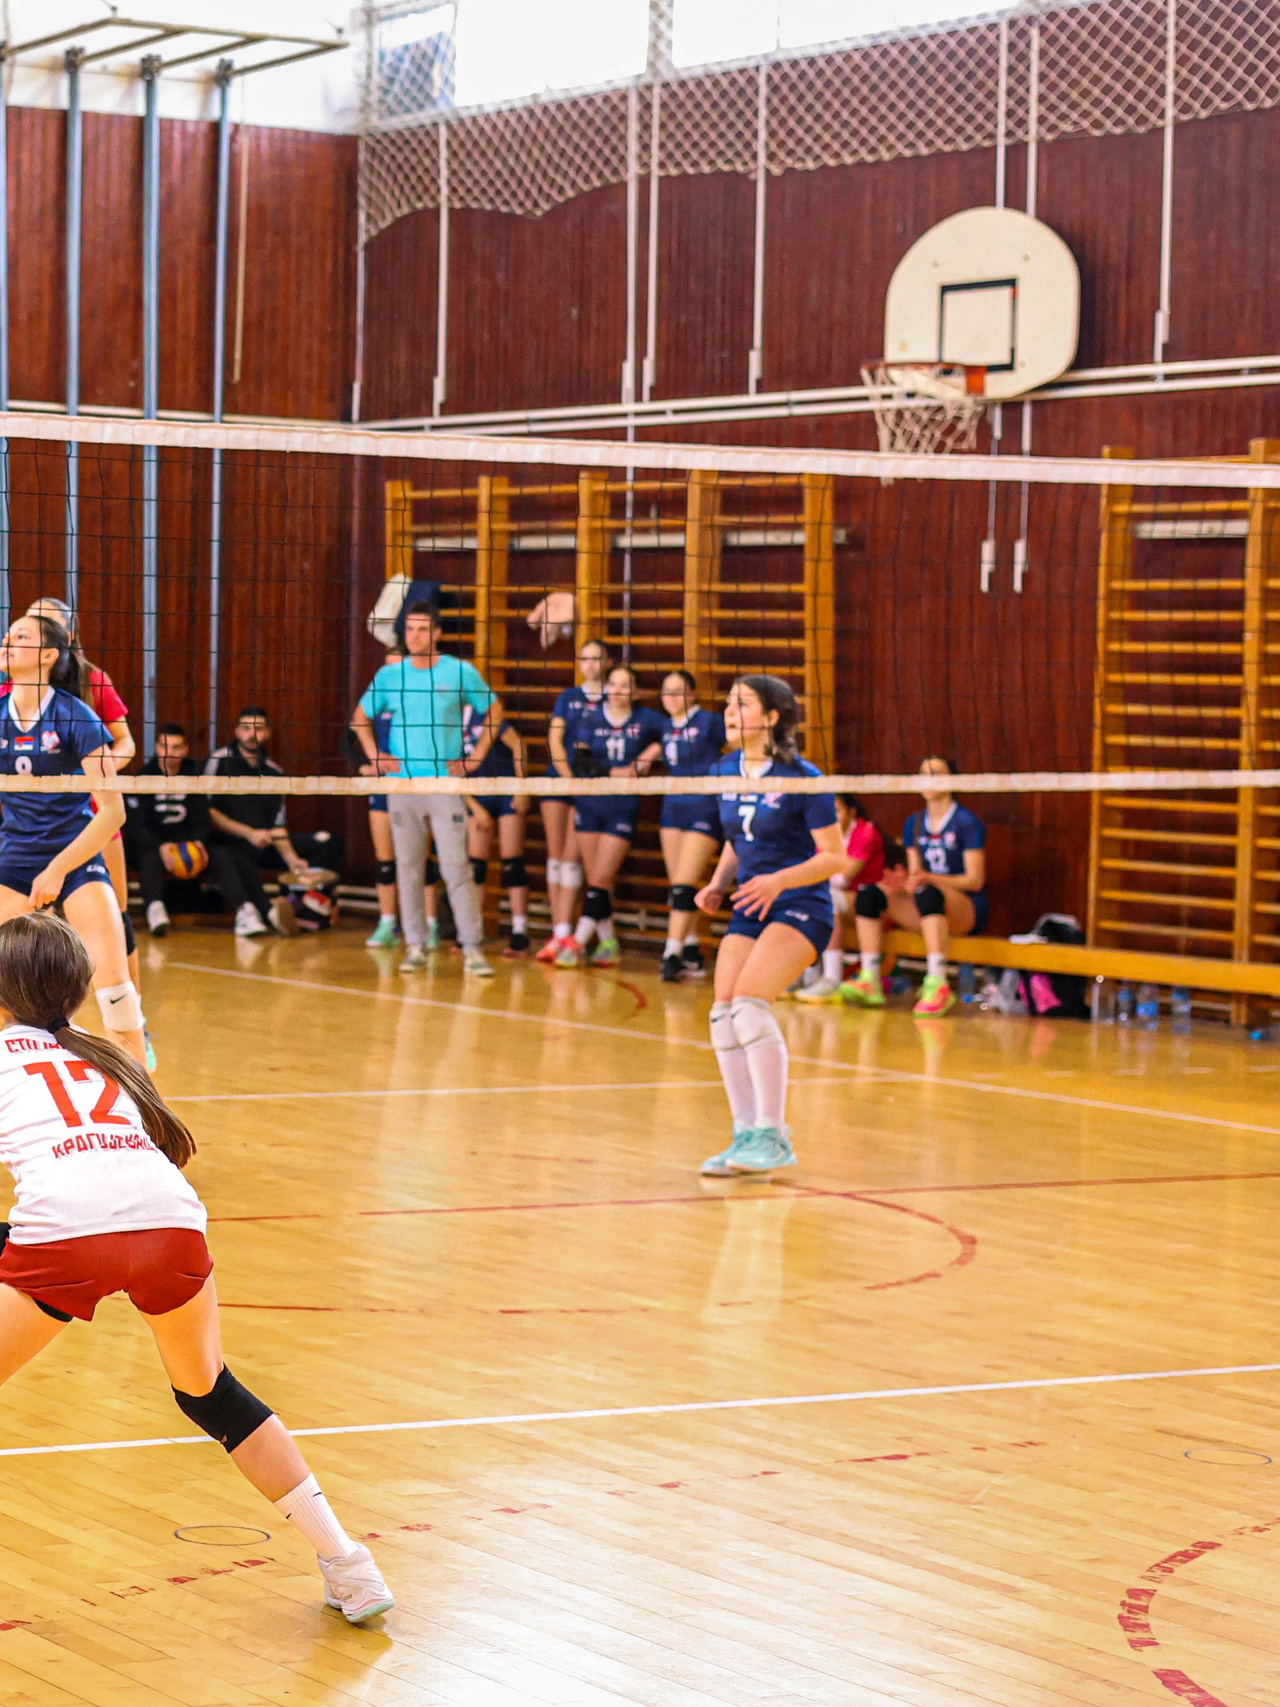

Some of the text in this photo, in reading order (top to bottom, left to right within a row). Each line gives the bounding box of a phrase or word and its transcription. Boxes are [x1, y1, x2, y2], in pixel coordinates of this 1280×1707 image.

[605, 736, 626, 762] 11
[738, 804, 756, 842] 7
[22, 1060, 132, 1128] 12
